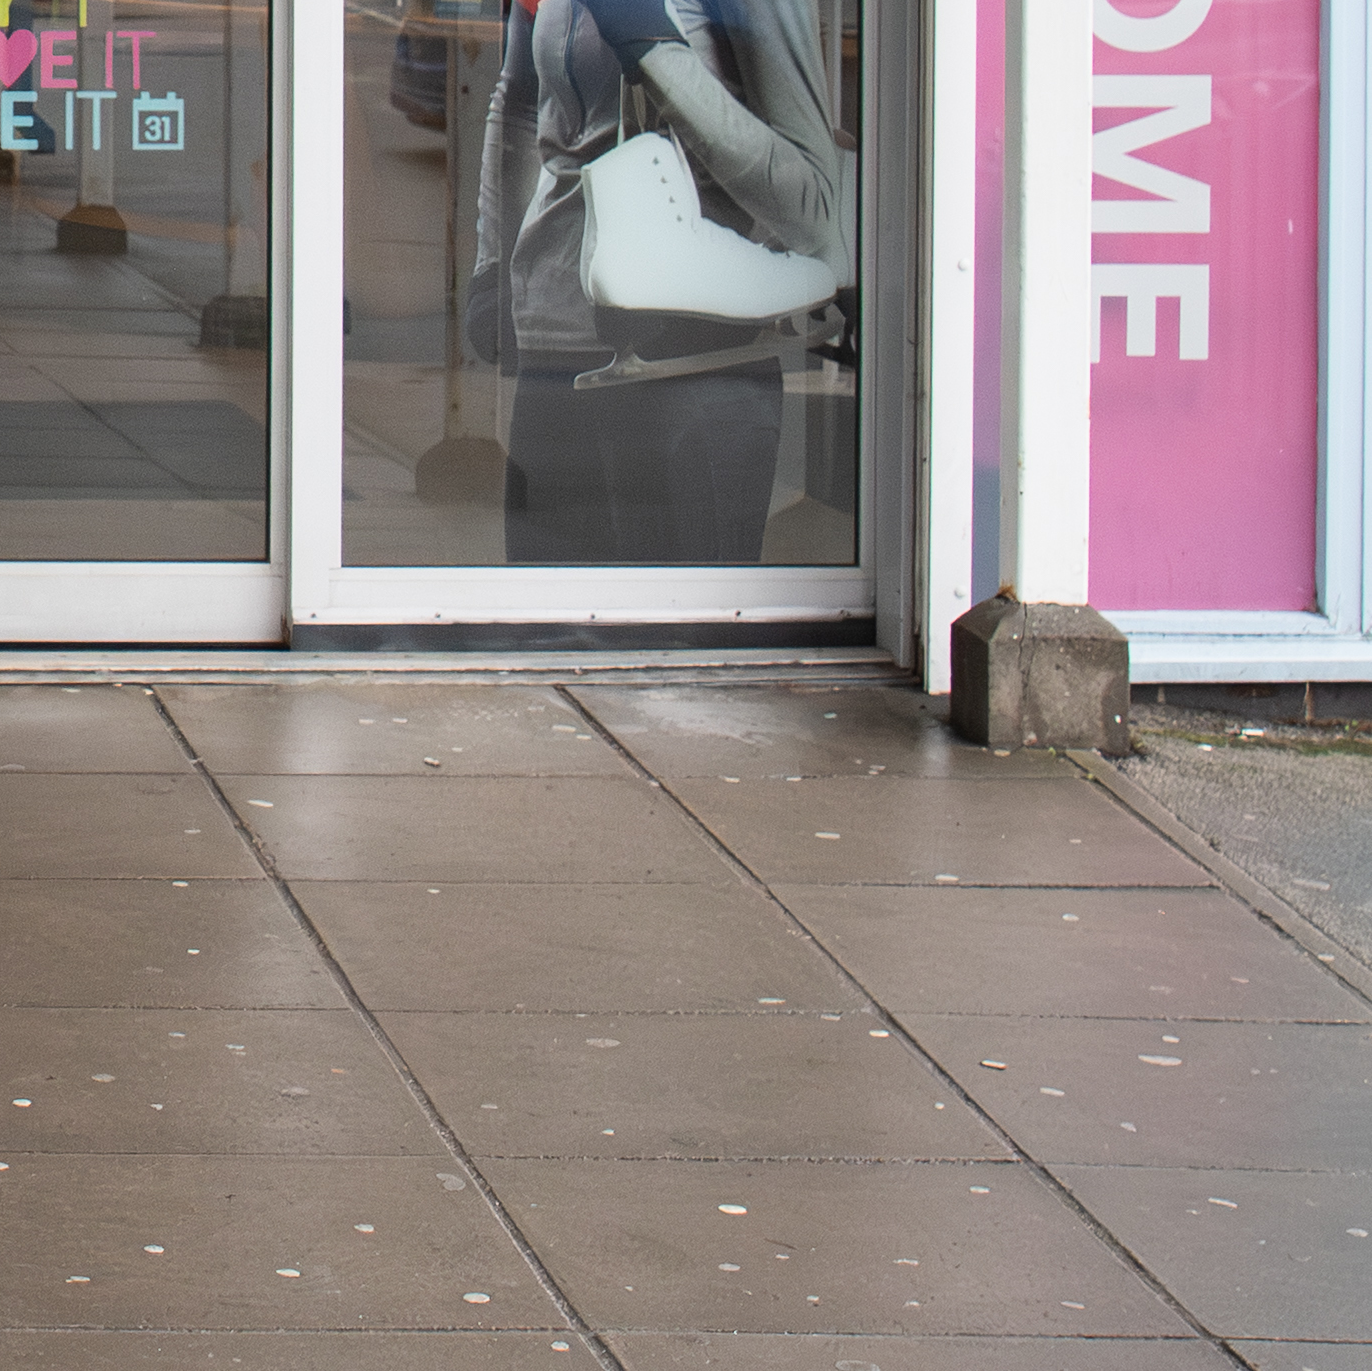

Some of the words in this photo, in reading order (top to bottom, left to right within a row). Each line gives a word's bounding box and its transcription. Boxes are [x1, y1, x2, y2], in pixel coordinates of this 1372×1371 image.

[105, 31, 156, 90] IT
[65, 91, 118, 151] IT
[144, 115, 171, 142] 31
